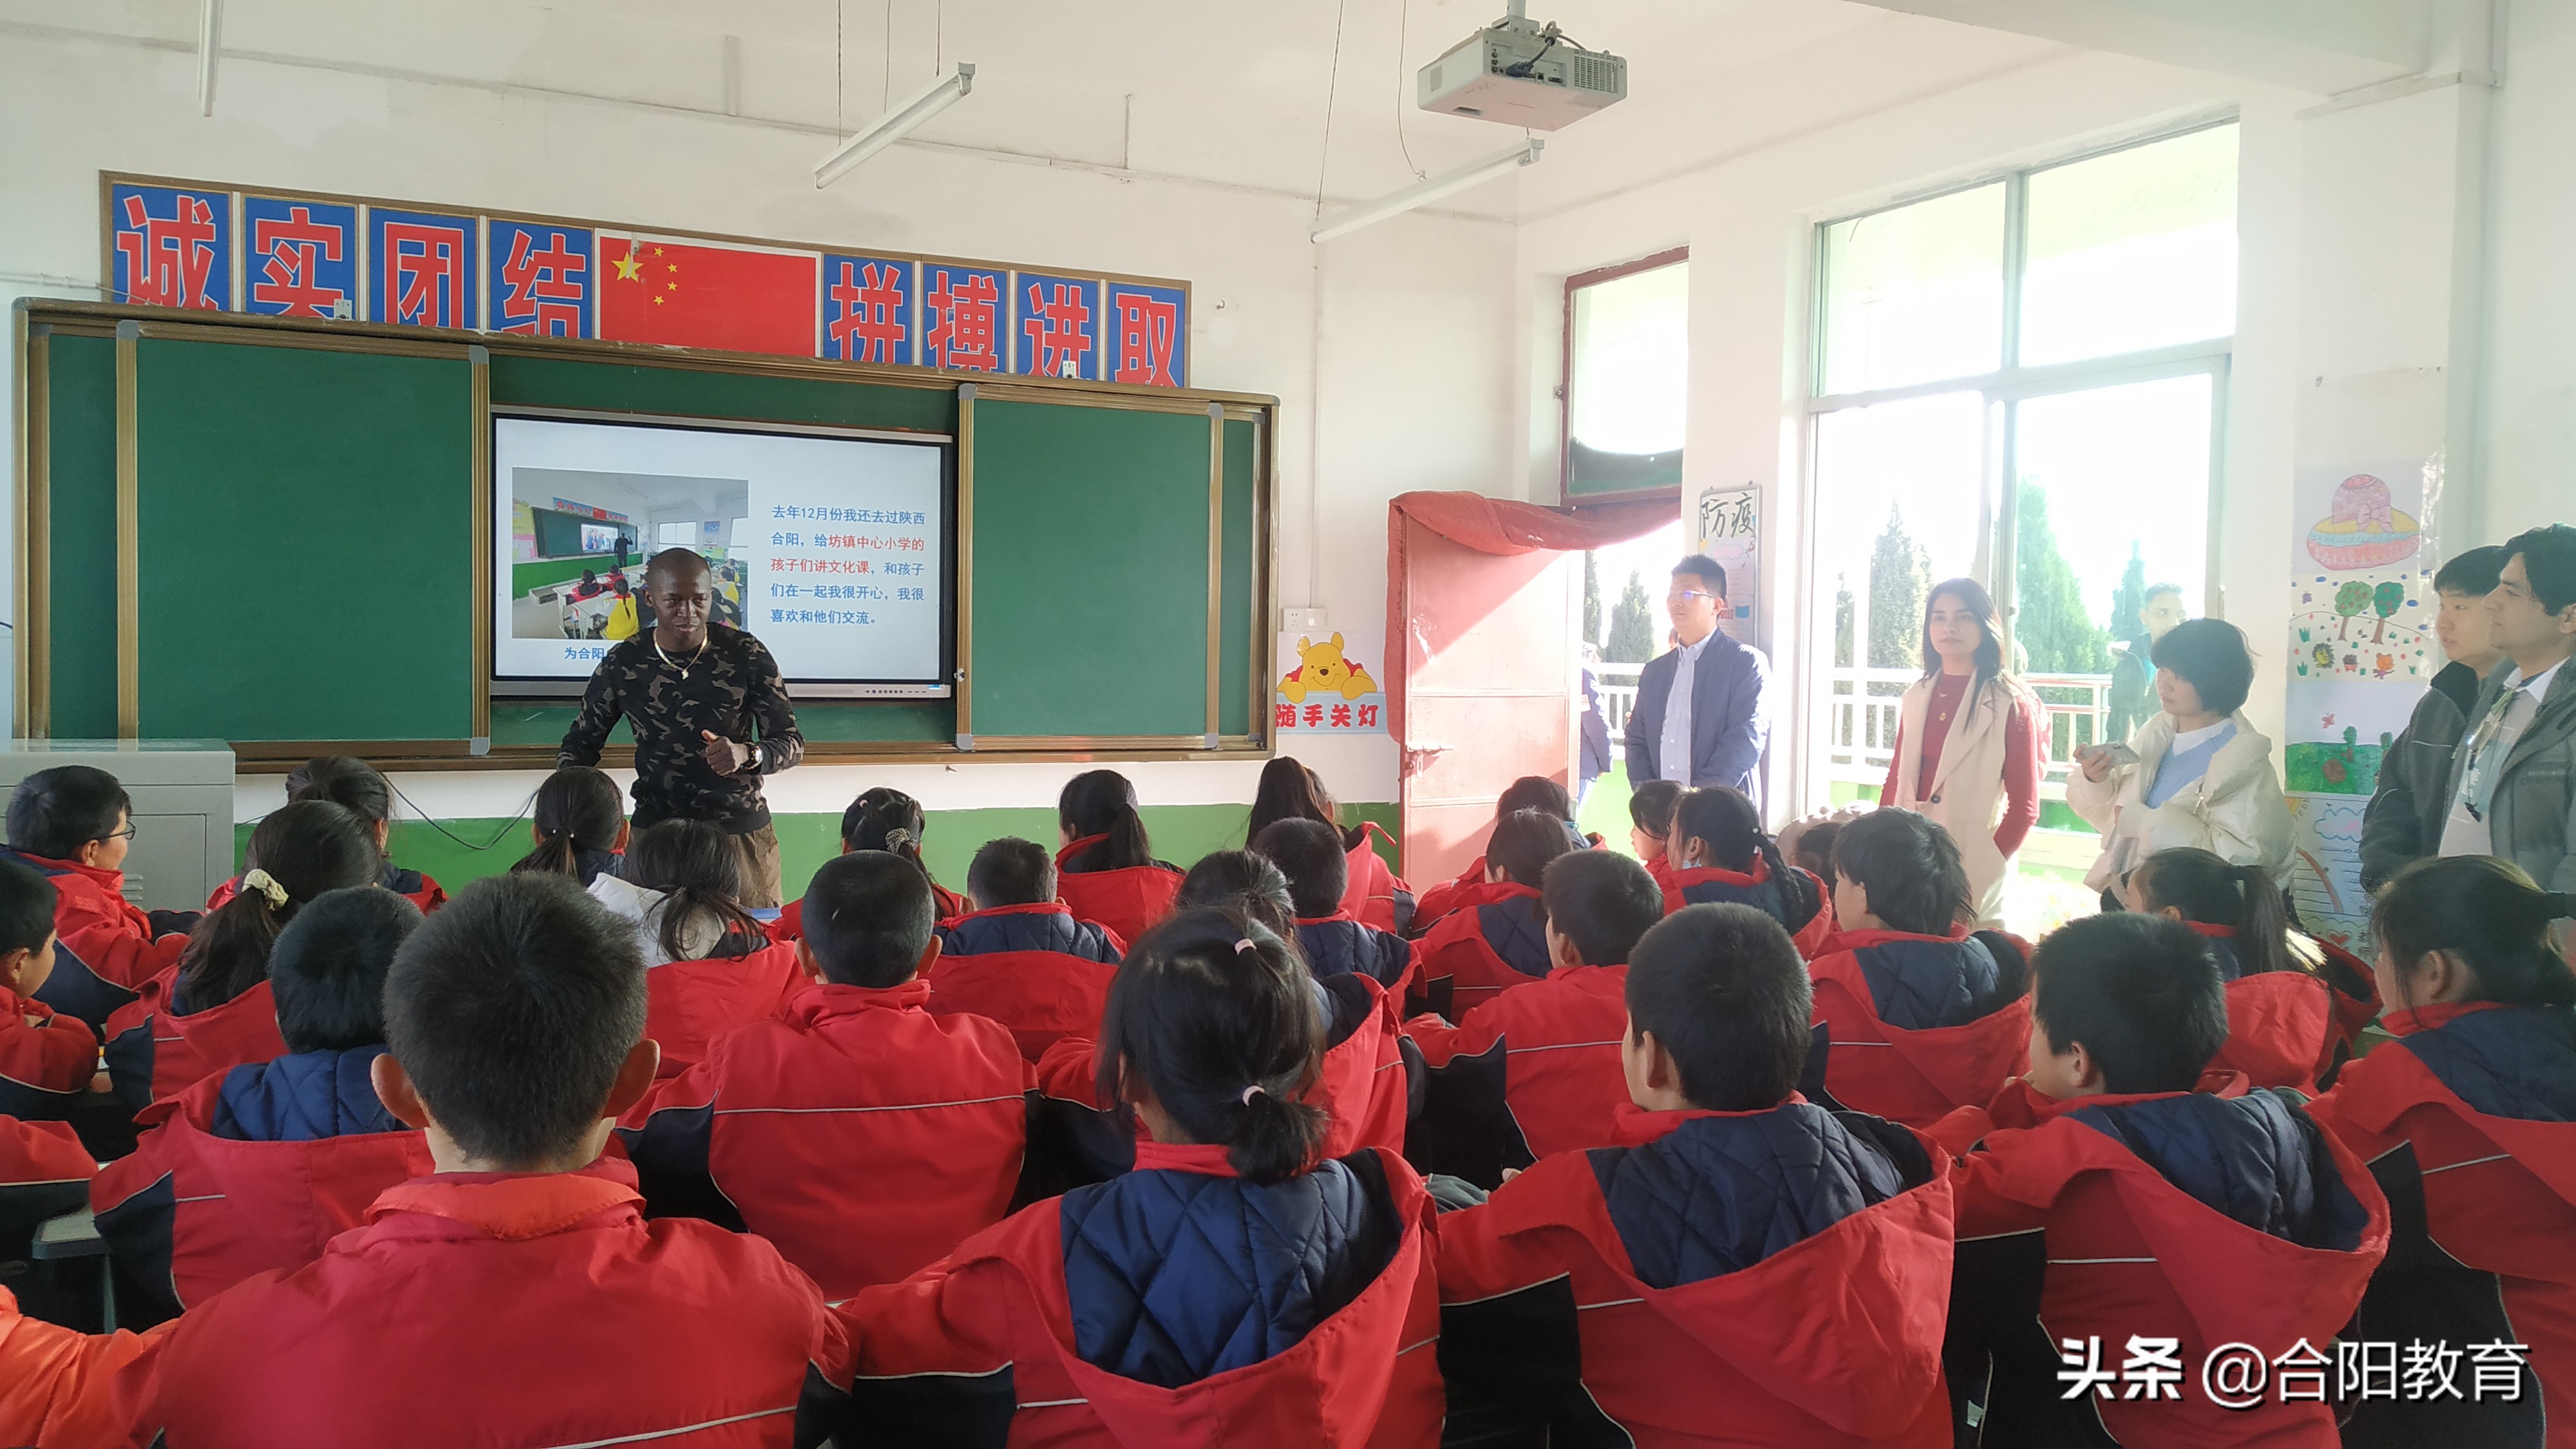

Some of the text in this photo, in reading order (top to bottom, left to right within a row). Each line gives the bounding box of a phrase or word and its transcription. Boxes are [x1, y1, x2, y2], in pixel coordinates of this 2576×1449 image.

[117, 194, 1184, 386] 诚实团结 拼搏进取
[771, 504, 925, 526] 去年12月份我还去过陕西
[1700, 492, 1754, 539] 防疫
[770, 558, 925, 576] 孩子们讲文化课，和孩子
[770, 583, 925, 601] 们在一起我很开心，我很
[770, 609, 876, 625] 喜欢和他们交流。
[564, 646, 605, 660] 为合阳
[1275, 703, 1379, 728] 随手关灯
